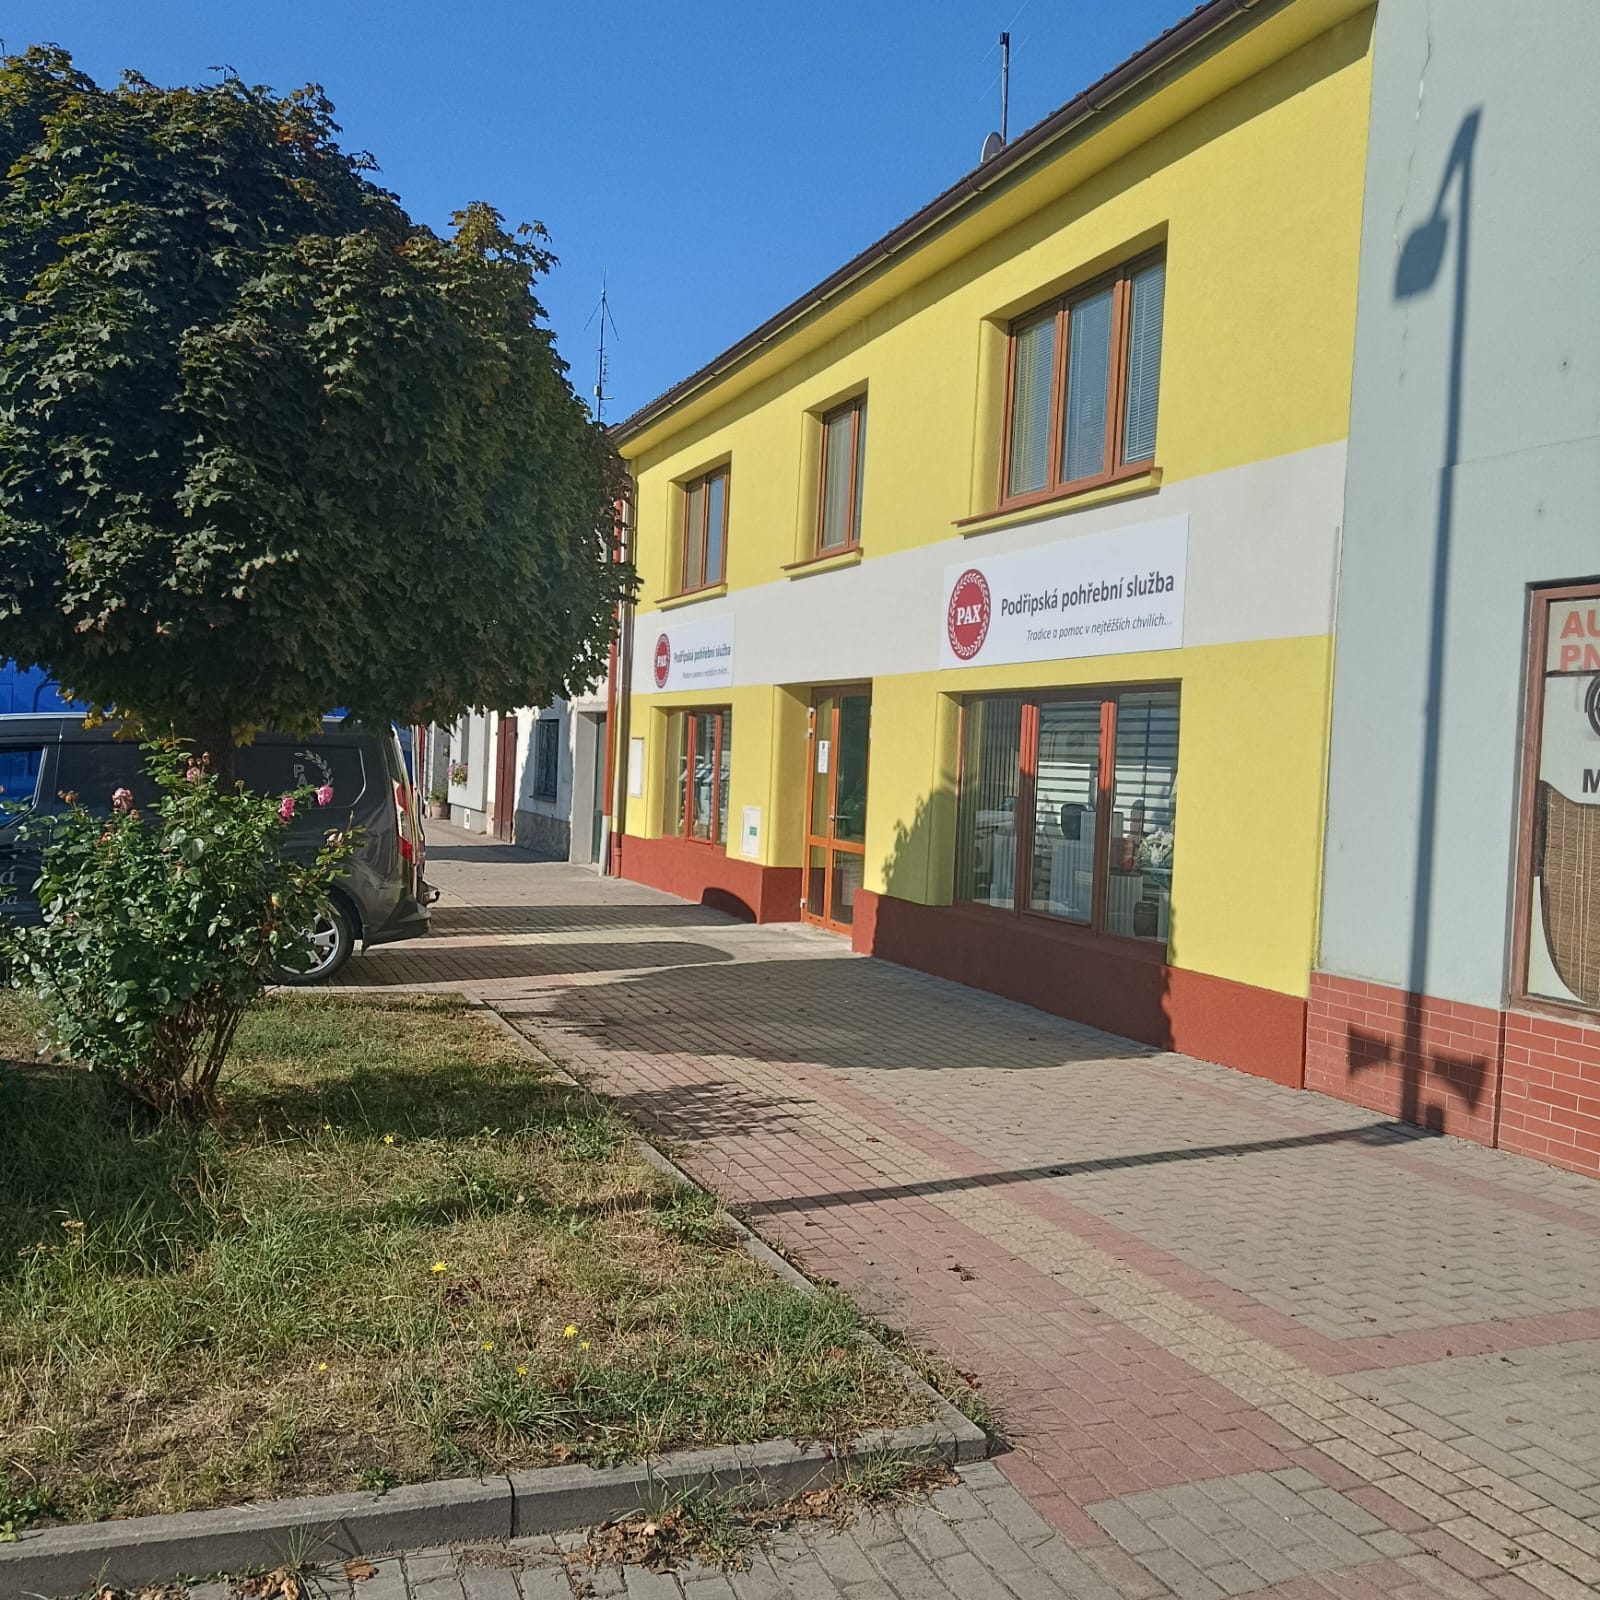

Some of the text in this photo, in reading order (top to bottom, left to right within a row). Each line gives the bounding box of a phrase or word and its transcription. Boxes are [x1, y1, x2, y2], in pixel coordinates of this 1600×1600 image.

[1001, 570, 1174, 616] Podřipská pohřební služba
[956, 603, 982, 626] PAX
[1027, 628, 1051, 641] Tradice
[1052, 629, 1058, 638] a
[1058, 625, 1084, 641] pomoc
[1560, 643, 1600, 673] PN
